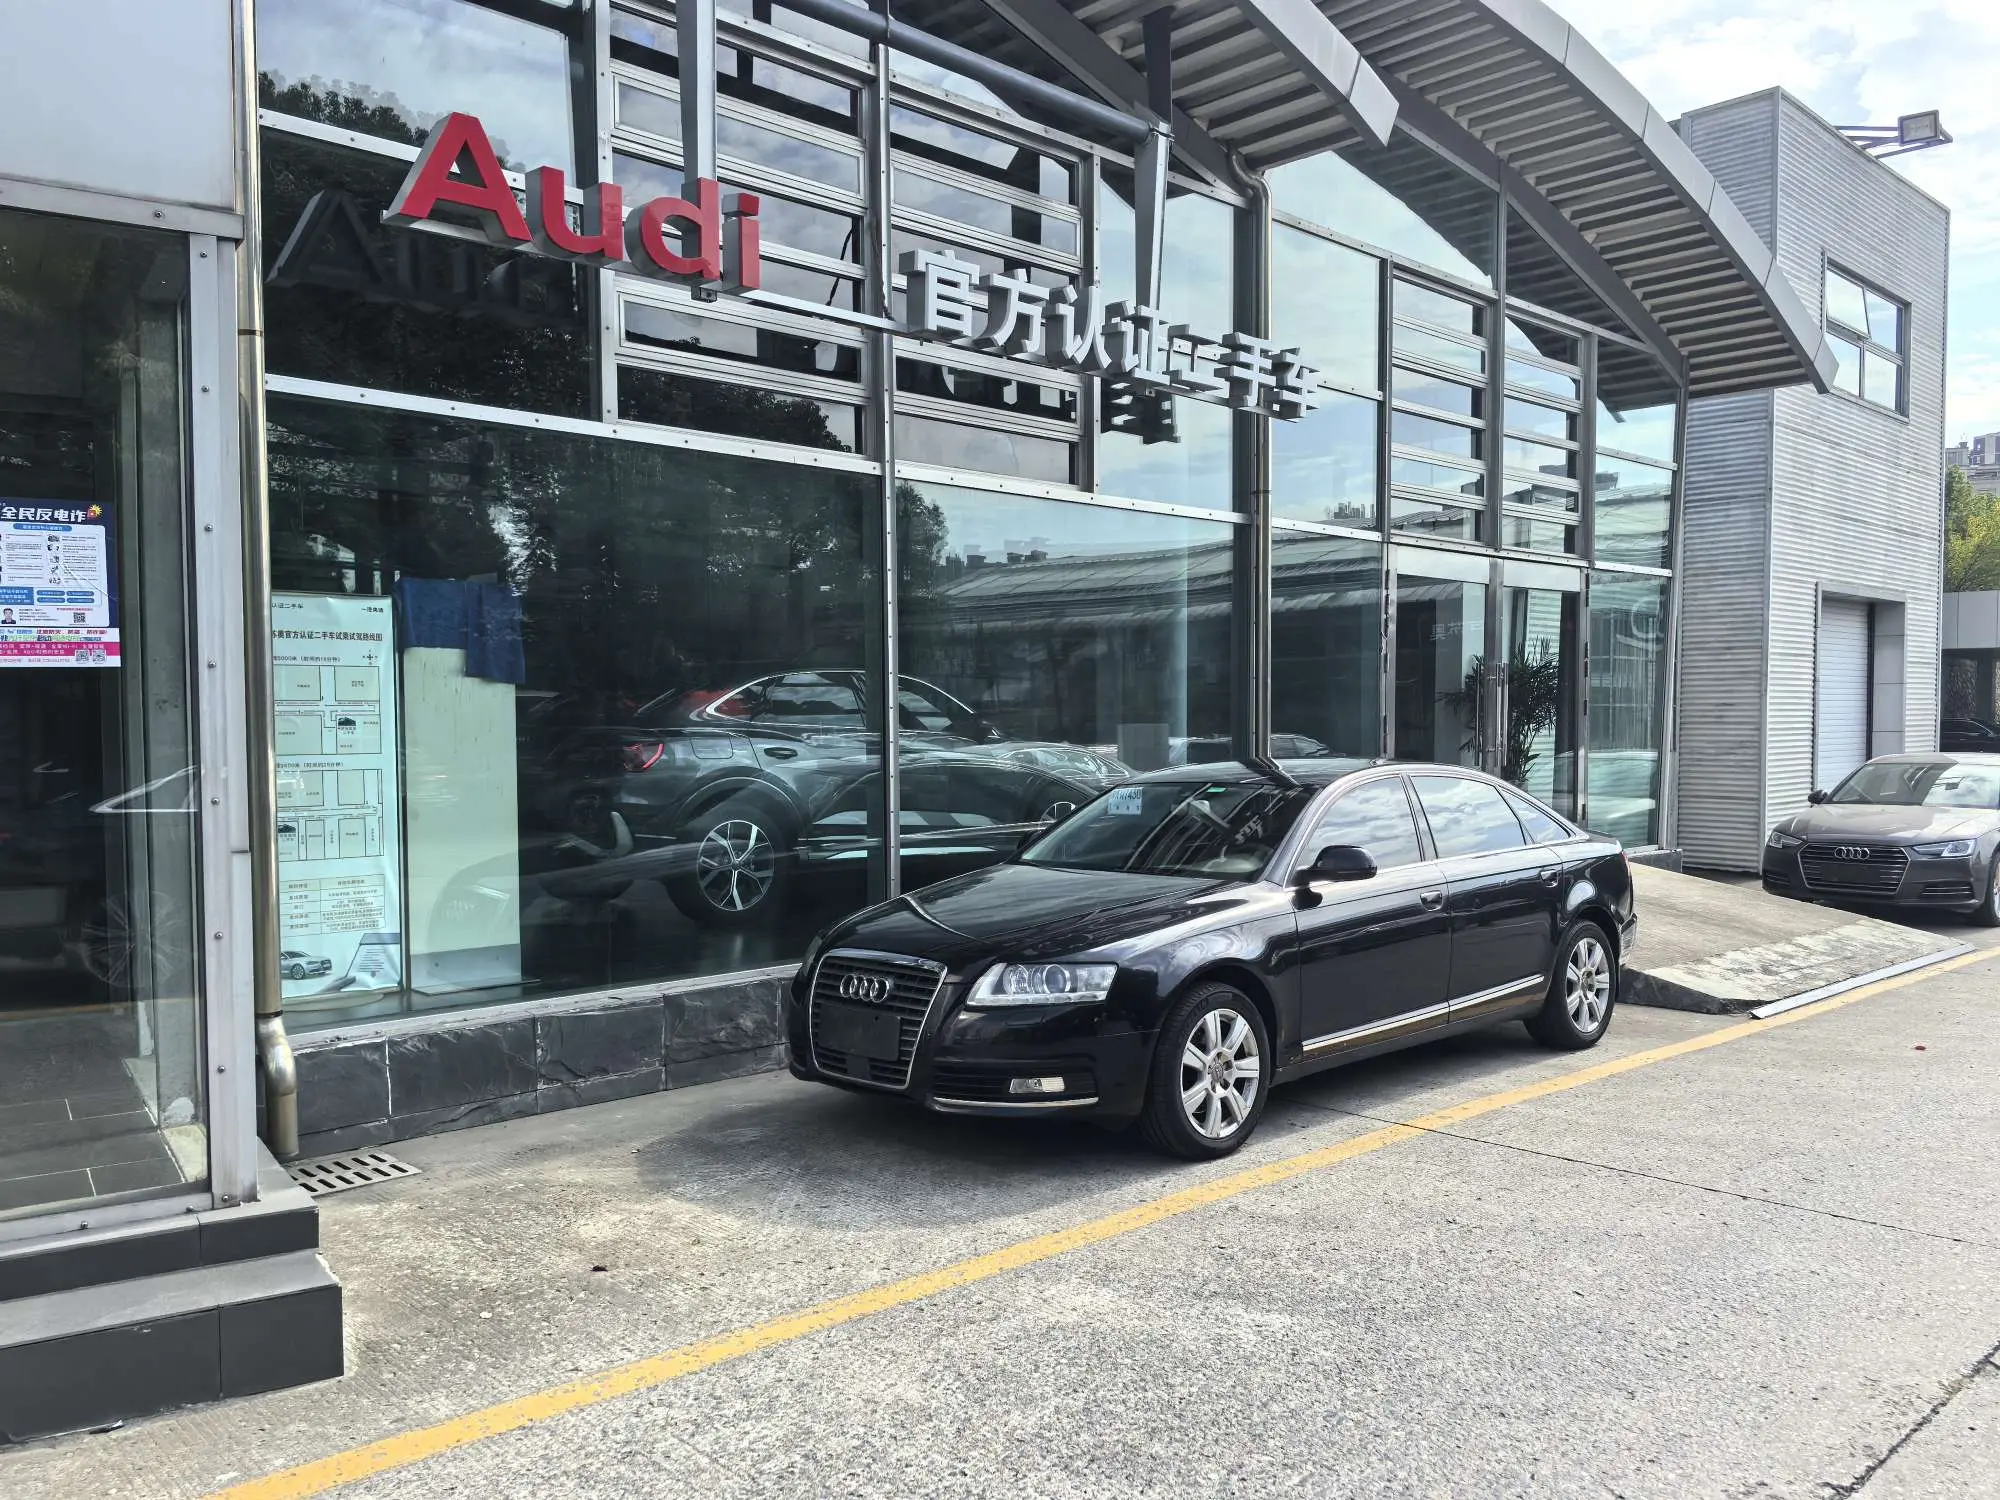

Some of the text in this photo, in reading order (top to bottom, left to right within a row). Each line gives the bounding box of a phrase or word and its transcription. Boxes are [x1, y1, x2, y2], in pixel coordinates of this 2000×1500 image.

[383, 112, 761, 292] Audi
[899, 249, 1320, 423] 官方认证二手车
[0, 506, 87, 522] 全民反电诈
